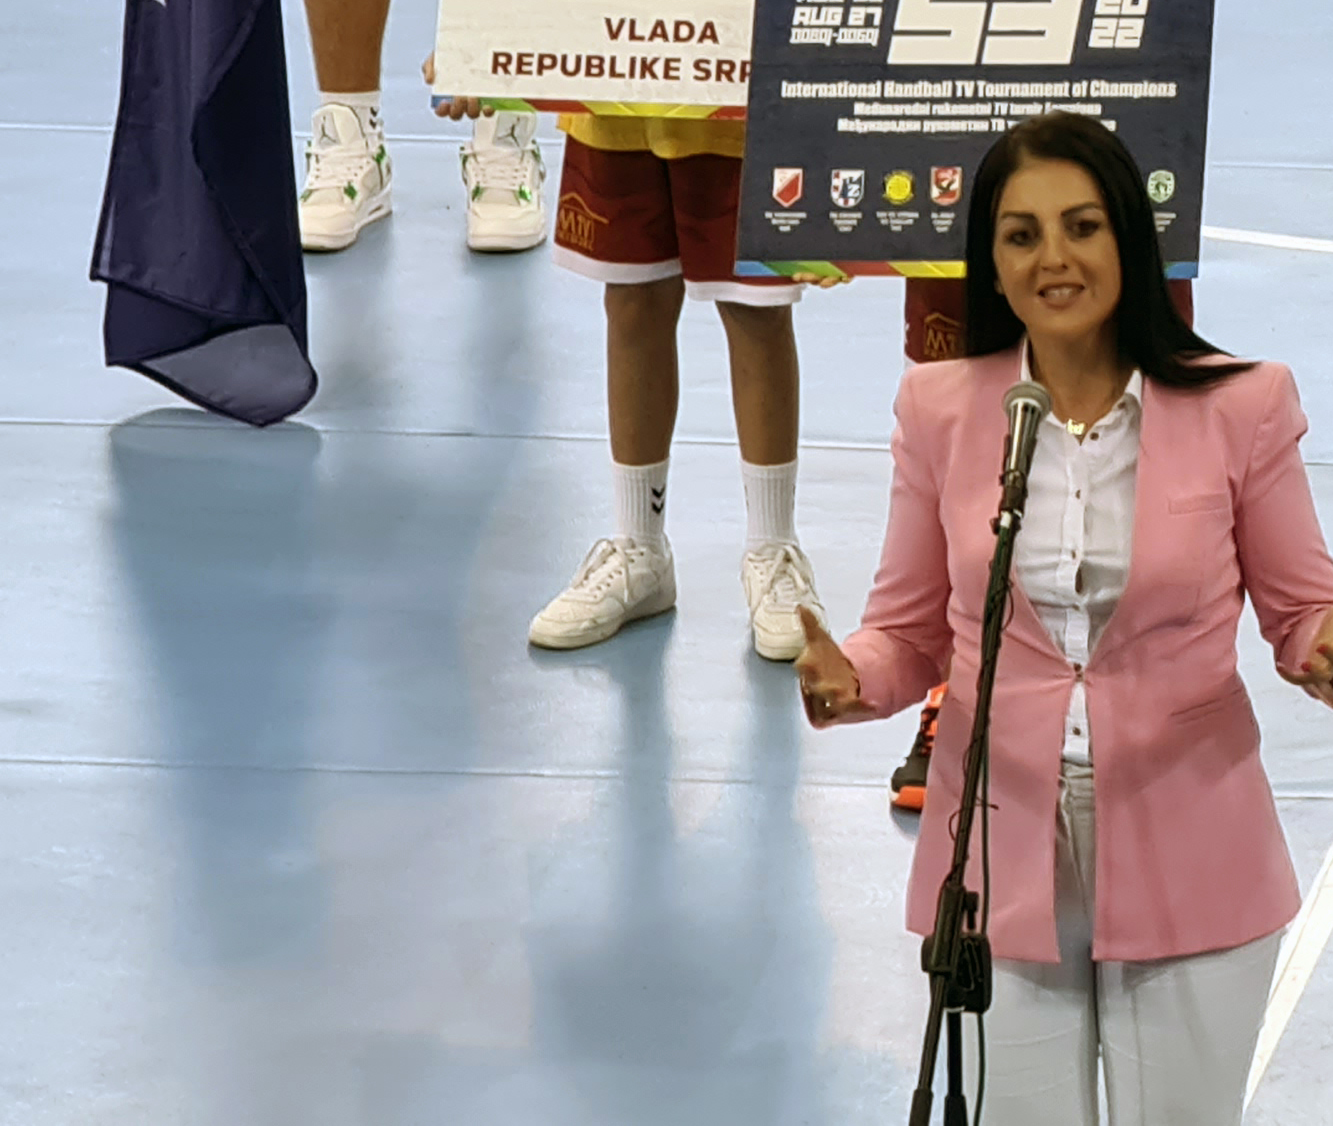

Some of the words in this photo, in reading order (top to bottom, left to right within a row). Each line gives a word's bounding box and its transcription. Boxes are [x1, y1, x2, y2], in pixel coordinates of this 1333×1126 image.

[792, 6, 844, 26] AUG
[847, 6, 883, 26] 27
[604, 17, 720, 45] VLADA
[1088, 17, 1145, 48] 22
[491, 50, 682, 81] REPUBLIKE
[692, 58, 752, 84] SRP
[781, 80, 882, 98] International
[883, 80, 953, 98] Handball
[955, 80, 975, 98] TV
[976, 80, 1070, 98] Tournament
[1072, 80, 1089, 98] of
[1089, 80, 1177, 99] Champions
